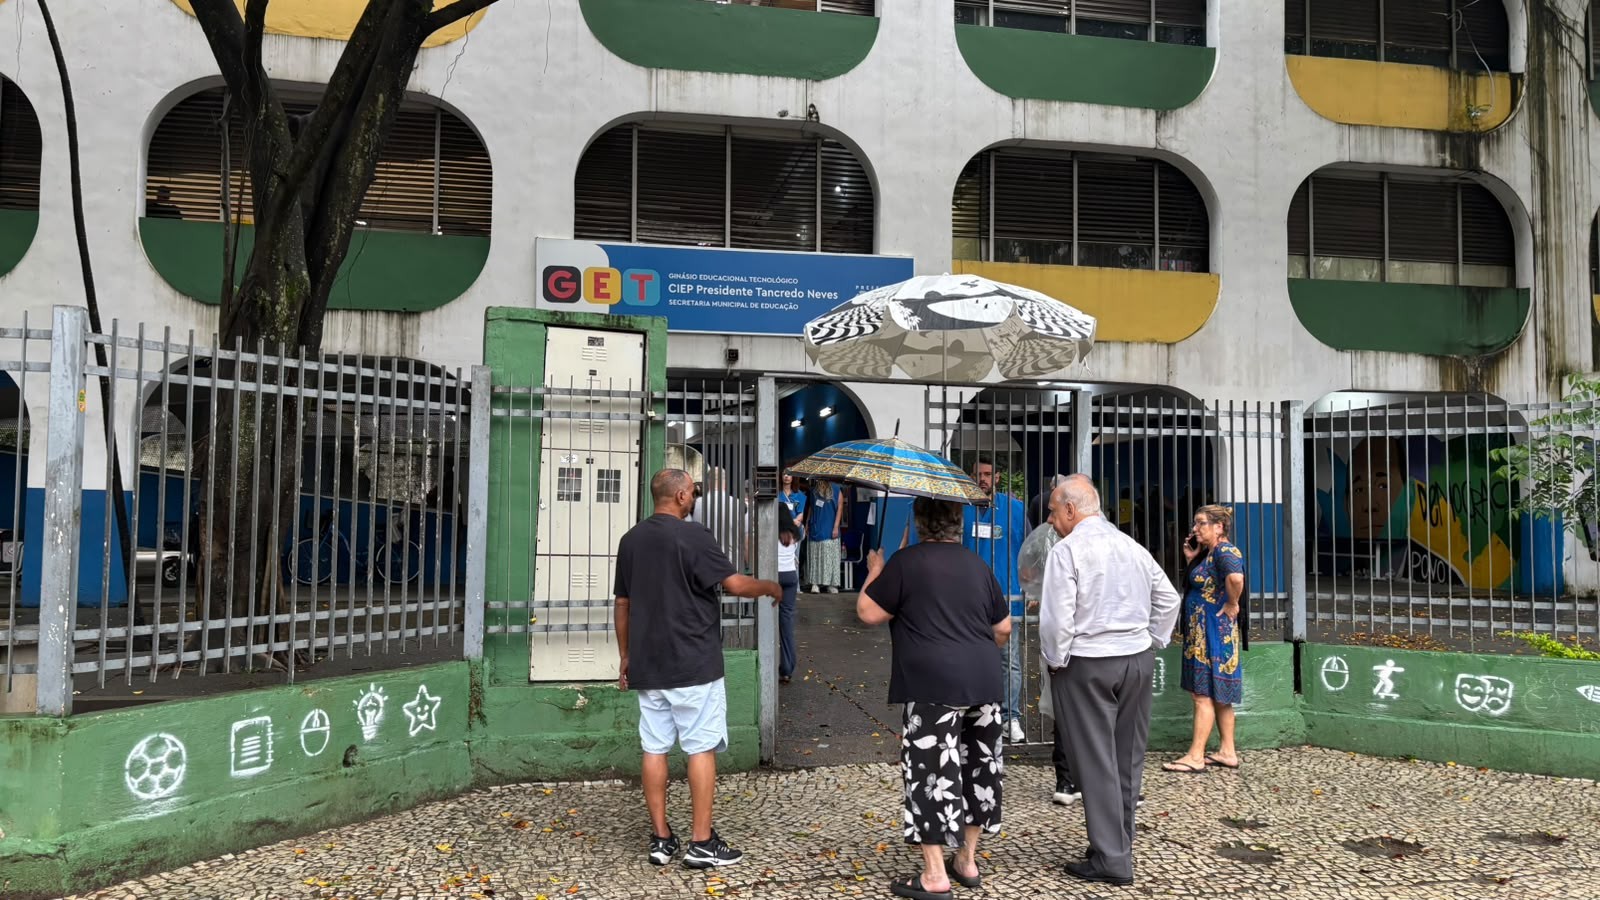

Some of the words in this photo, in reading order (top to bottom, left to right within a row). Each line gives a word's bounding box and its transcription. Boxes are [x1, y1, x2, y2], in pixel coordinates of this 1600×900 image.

[547, 270, 654, 301] GET
[668, 272, 698, 280] GINÁSIO
[699, 274, 748, 282] EDUCACIONAL
[749, 276, 799, 284] TECNOLÓGICO
[668, 283, 694, 294] CIEP
[696, 285, 753, 297] Presidente
[755, 287, 805, 299] Tancredo
[807, 289, 839, 300] Neves
[668, 299, 711, 307] SECRETARIA
[711, 301, 749, 309] MUNICIPAL
[760, 302, 799, 311] EDUCAÇÃO
[1411, 551, 1446, 583] POVO
